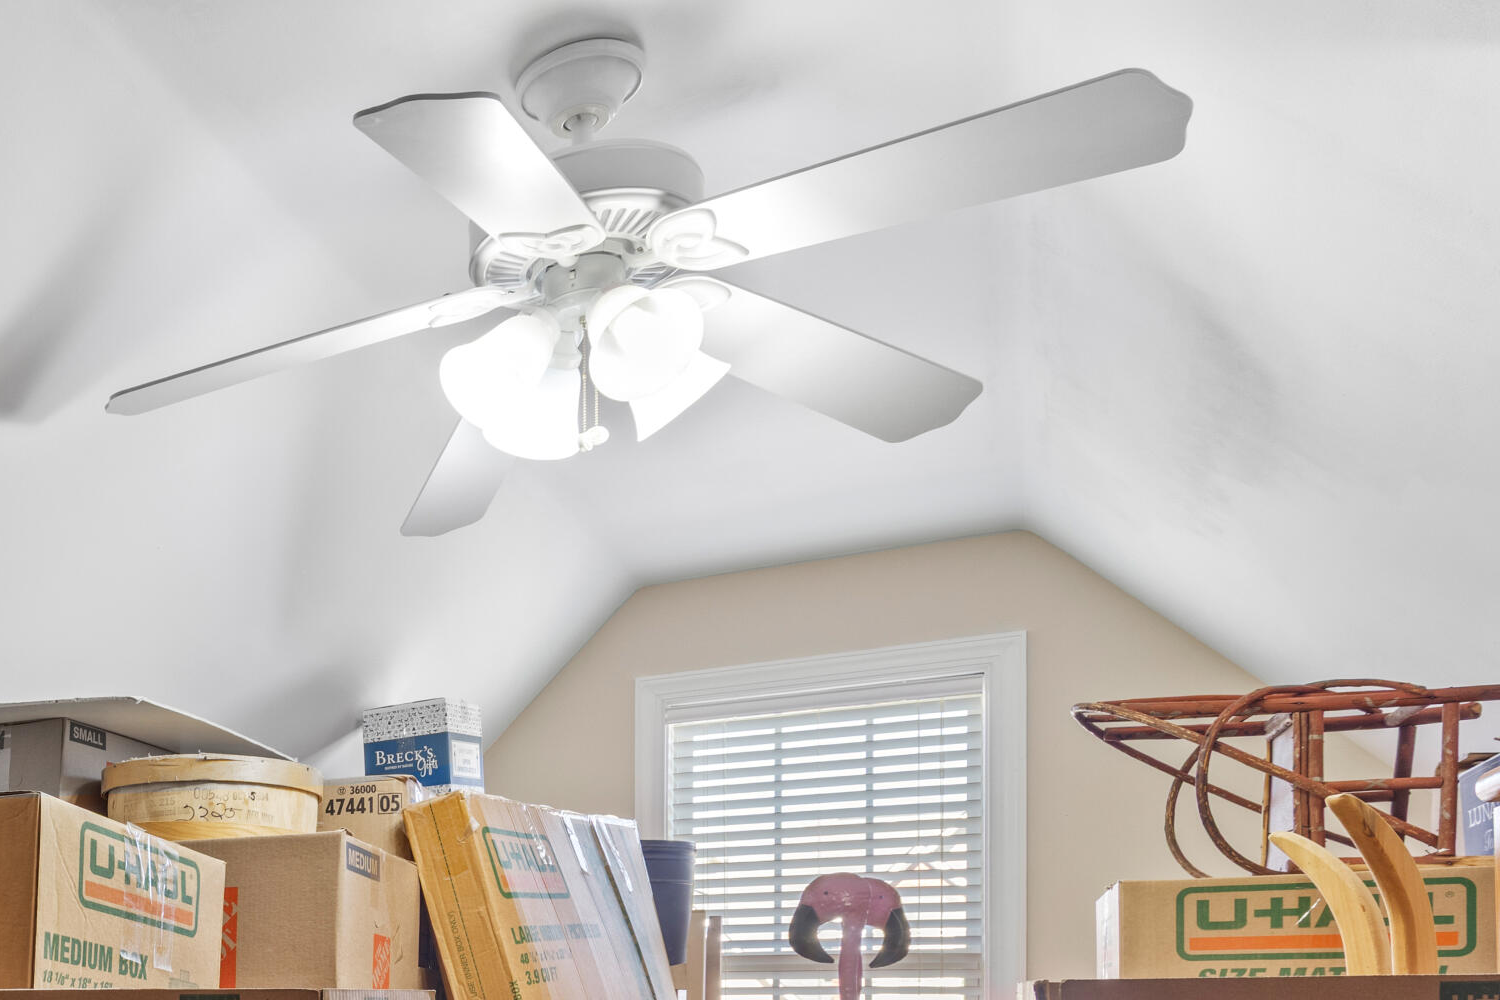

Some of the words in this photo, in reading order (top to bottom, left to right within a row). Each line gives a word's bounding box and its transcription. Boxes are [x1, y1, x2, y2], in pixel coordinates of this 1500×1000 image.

[73, 726, 103, 746] SMALL
[350, 784, 377, 794] 36000
[325, 797, 374, 816] 47441
[379, 794, 400, 812] 05
[348, 847, 378, 876] MEDIUM
[43, 932, 114, 973] MEDIUM
[118, 949, 149, 980] BOX
[43, 970, 55, 983] 18
